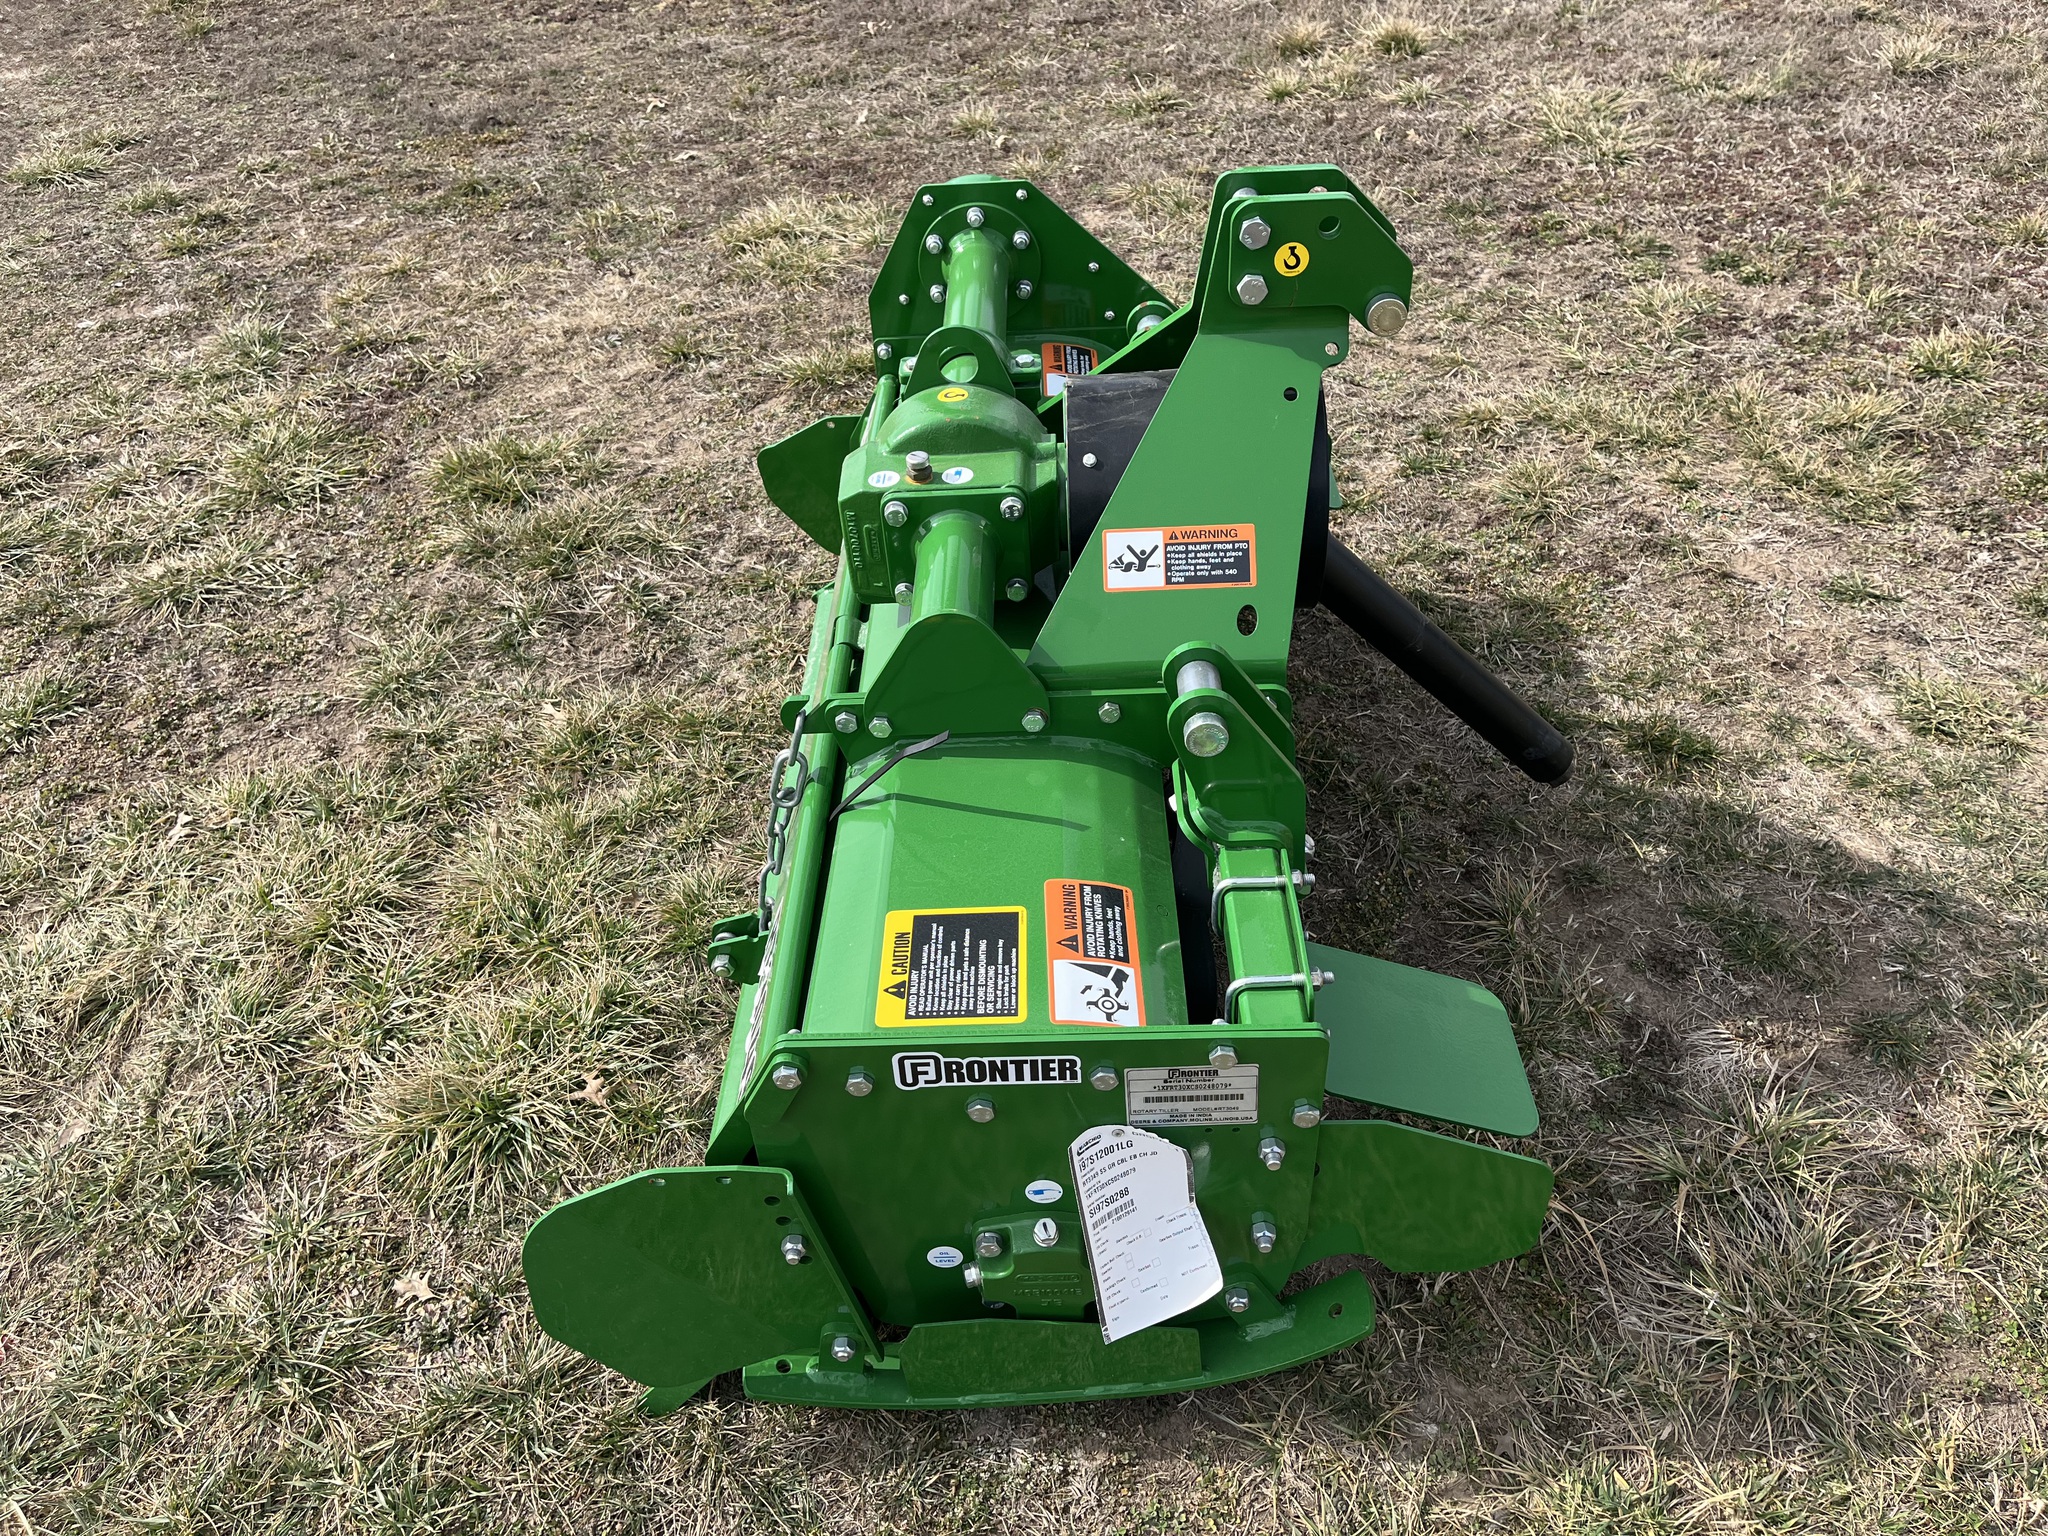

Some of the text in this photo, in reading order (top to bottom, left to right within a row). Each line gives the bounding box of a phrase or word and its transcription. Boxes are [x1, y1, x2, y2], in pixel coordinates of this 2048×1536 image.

[1180, 529, 1238, 540] WARNING
[1063, 884, 1077, 929] WARNING
[1083, 886, 1096, 956] AVOID INJURY FROM
[1093, 894, 1105, 957] ROTATING KNIVES
[891, 932, 910, 975] CAUTION
[908, 970, 919, 1015] AVOID INJURY
[977, 940, 987, 1013] BEFORE DISMOUNTING
[987, 965, 995, 1013] OR SERVICING
[898, 1055, 1078, 1087] FRONTIER
[1168, 1068, 1219, 1079] FRONTIER
[1089, 1187, 1129, 1218] SI97S0288
